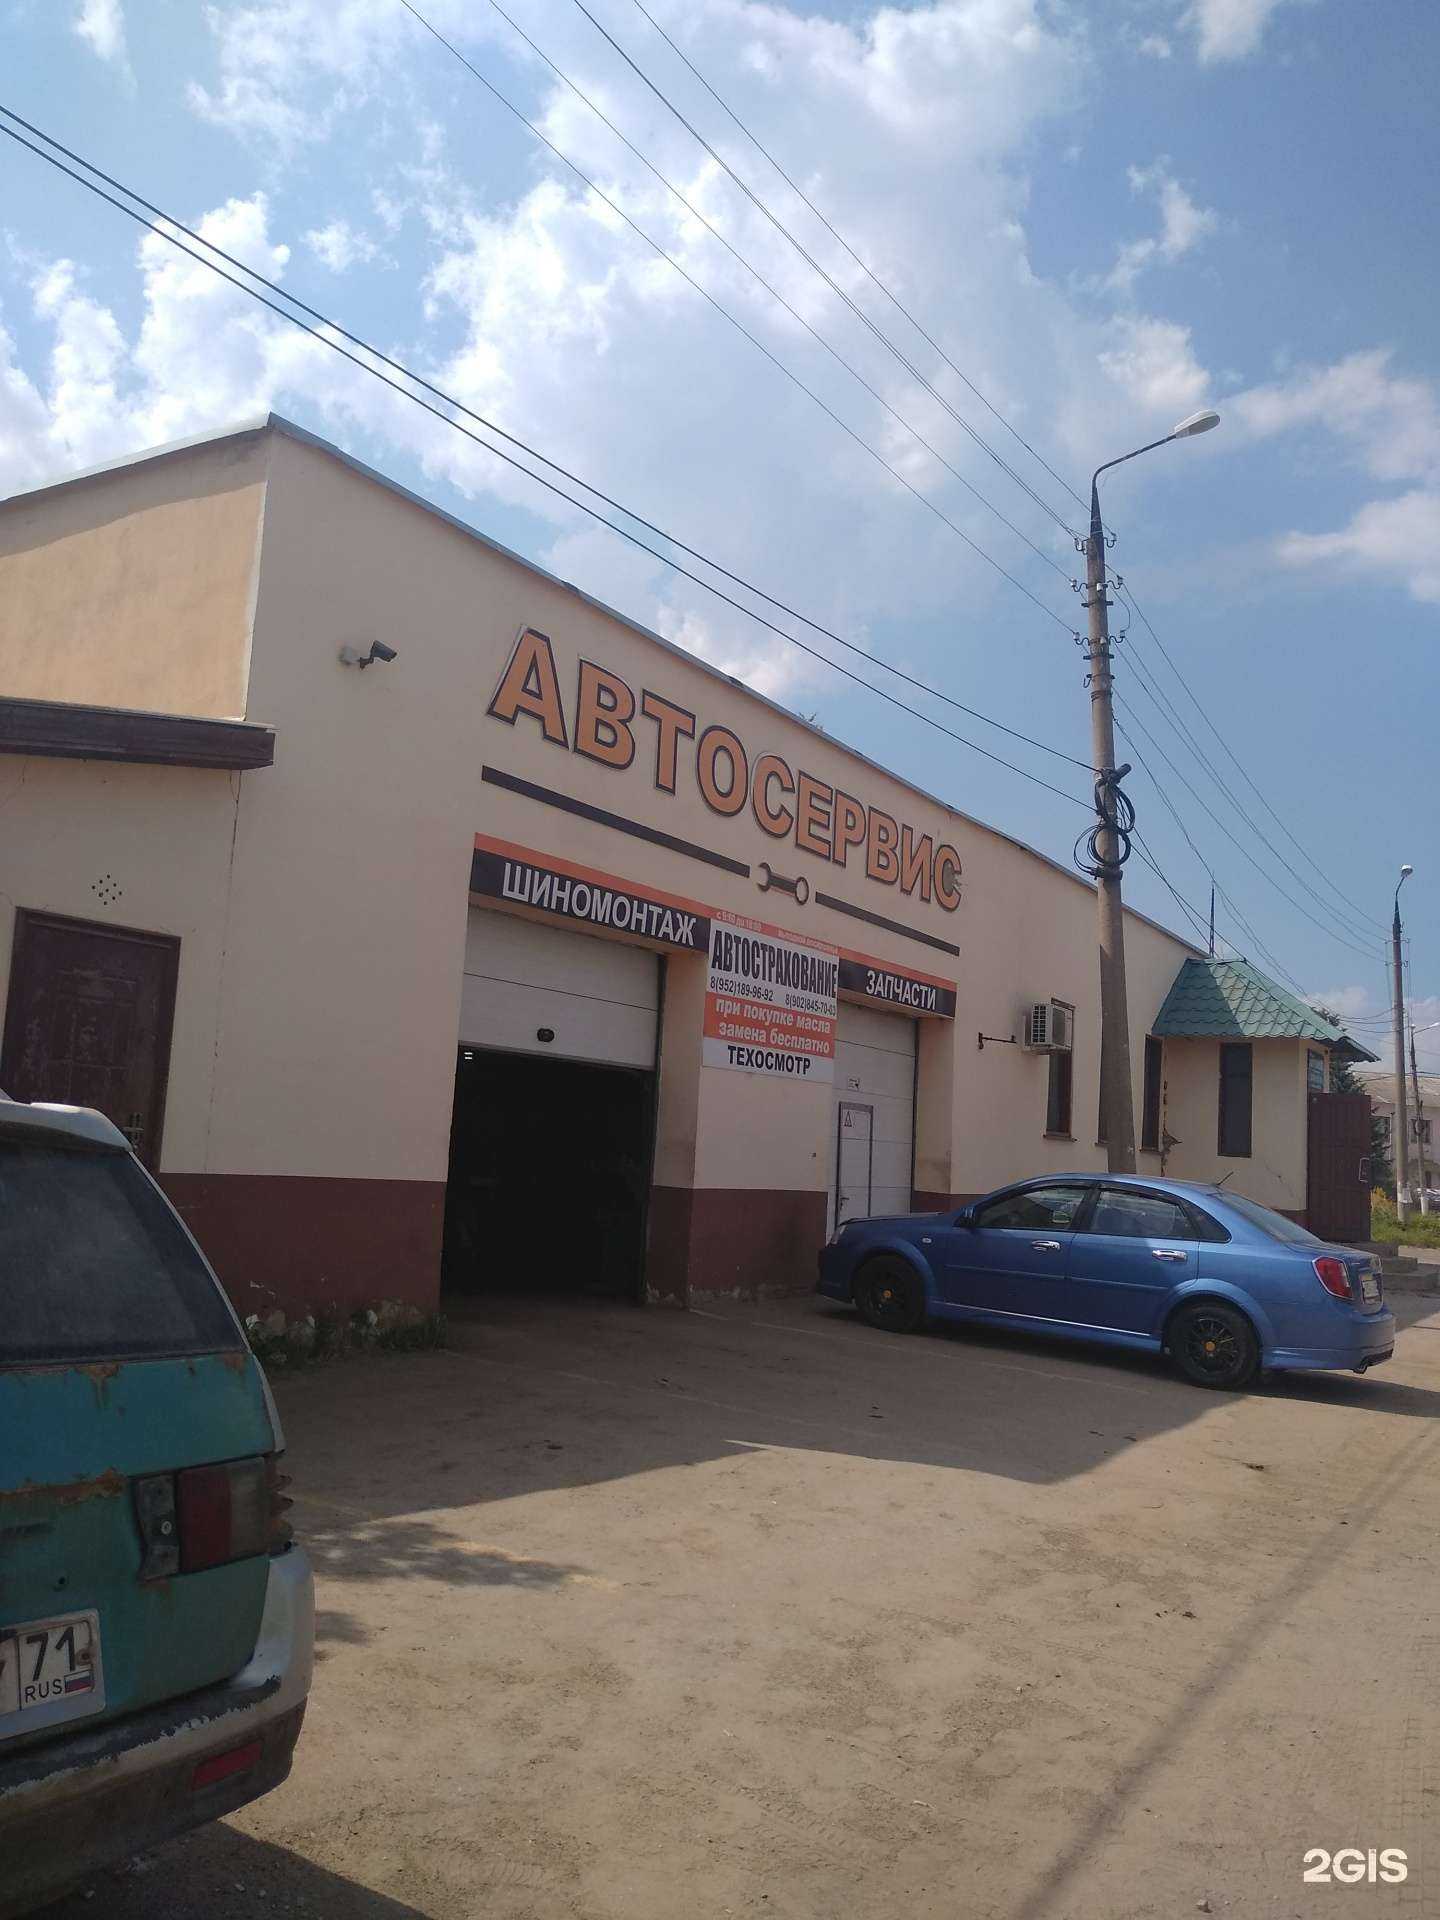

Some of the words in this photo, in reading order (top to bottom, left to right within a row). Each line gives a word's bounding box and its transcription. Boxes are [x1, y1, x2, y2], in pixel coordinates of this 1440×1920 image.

[485, 624, 963, 912] АВТОСЕРВИС
[502, 862, 697, 947] ШИНОМОНТАЖ
[711, 930, 838, 999] АВТОСТРАХОВАНИЕ
[710, 976, 774, 1002] 8(952)189-96-92
[865, 969, 936, 1010] ЗАПЧАСТИ
[715, 998, 742, 1018] при
[743, 1003, 794, 1027] покупке
[796, 1015, 831, 1034] масла
[719, 1022, 767, 1043] замена
[770, 1028, 830, 1054] бесплатно
[727, 1045, 811, 1075] ТЕХОСМОТР
[26, 1626, 76, 1682] 71
[25, 1679, 63, 1703] RUS
